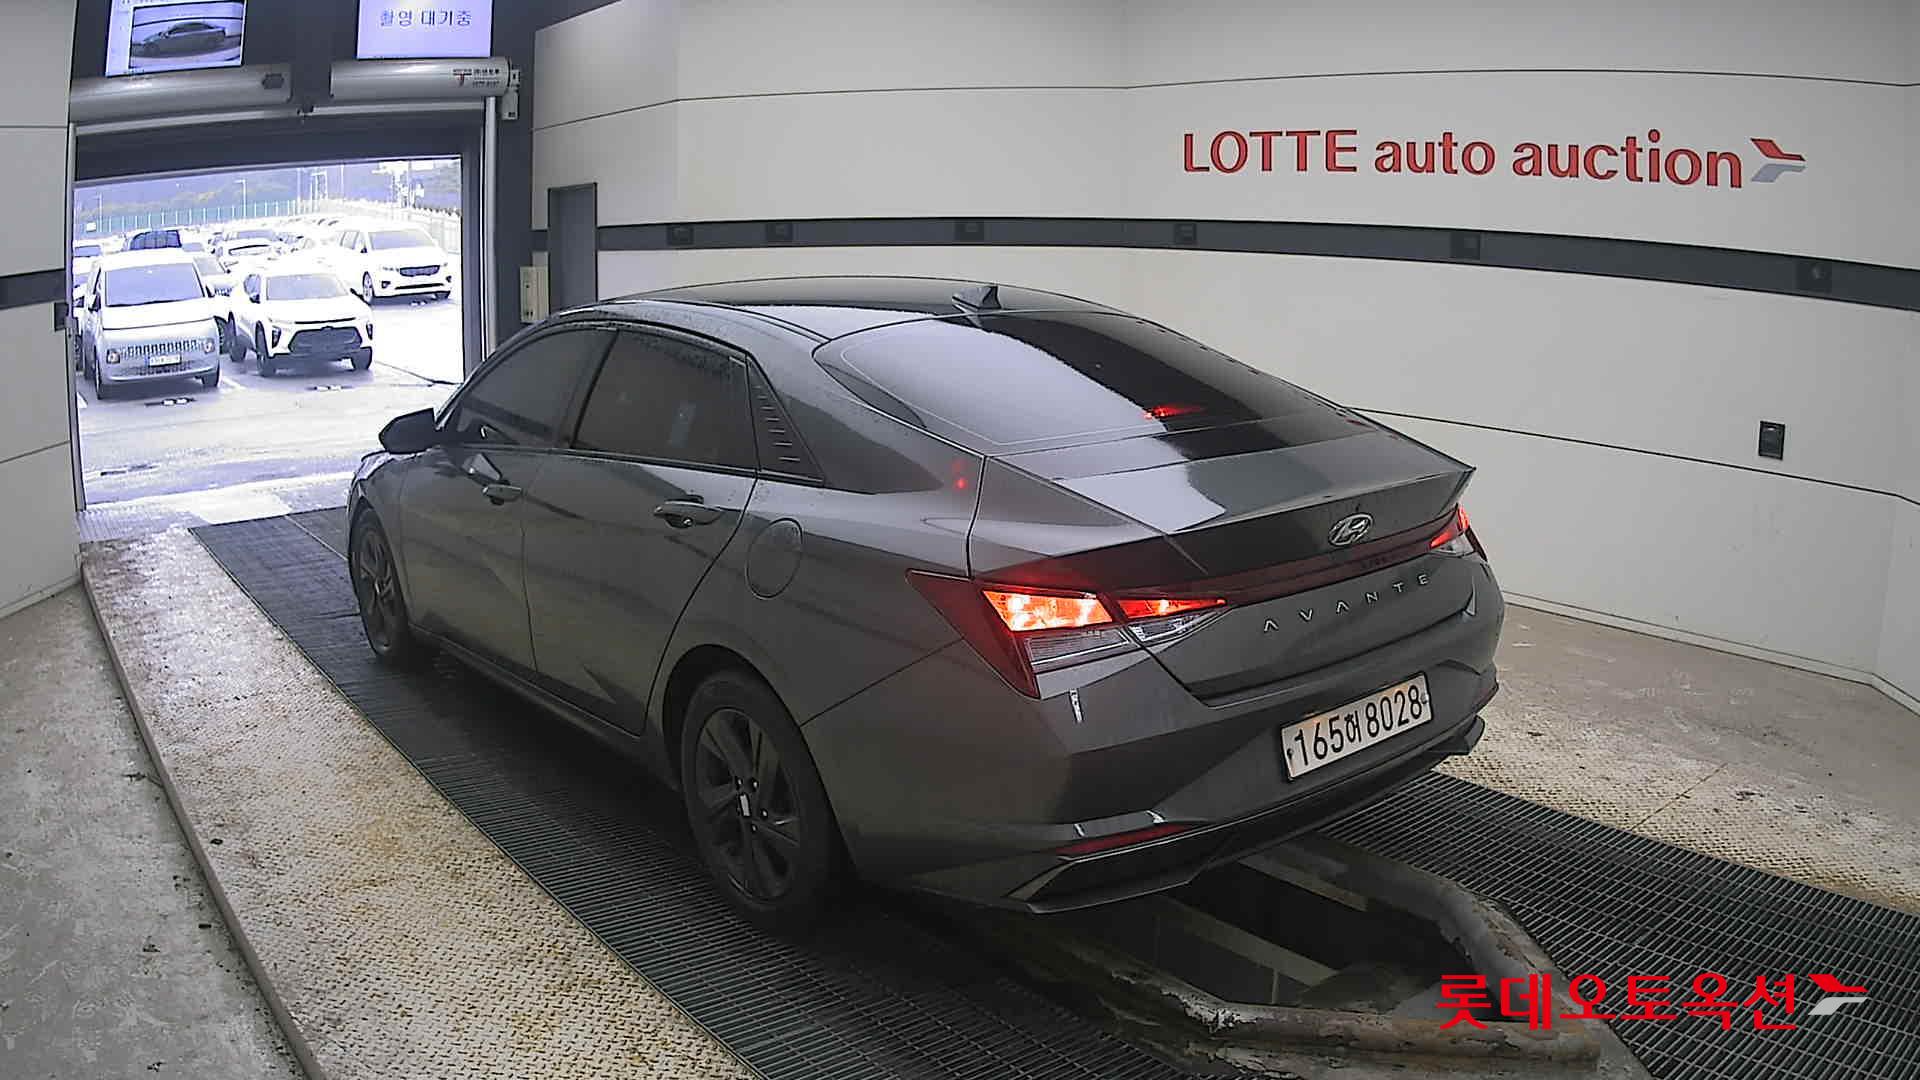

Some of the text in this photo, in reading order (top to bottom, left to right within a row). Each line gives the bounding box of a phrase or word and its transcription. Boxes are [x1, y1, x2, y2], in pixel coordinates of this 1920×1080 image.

[421, 9, 472, 27] 대기중
[1184, 128, 1743, 189] LOTTE auto auction
[1263, 573, 1430, 632] AVANTE
